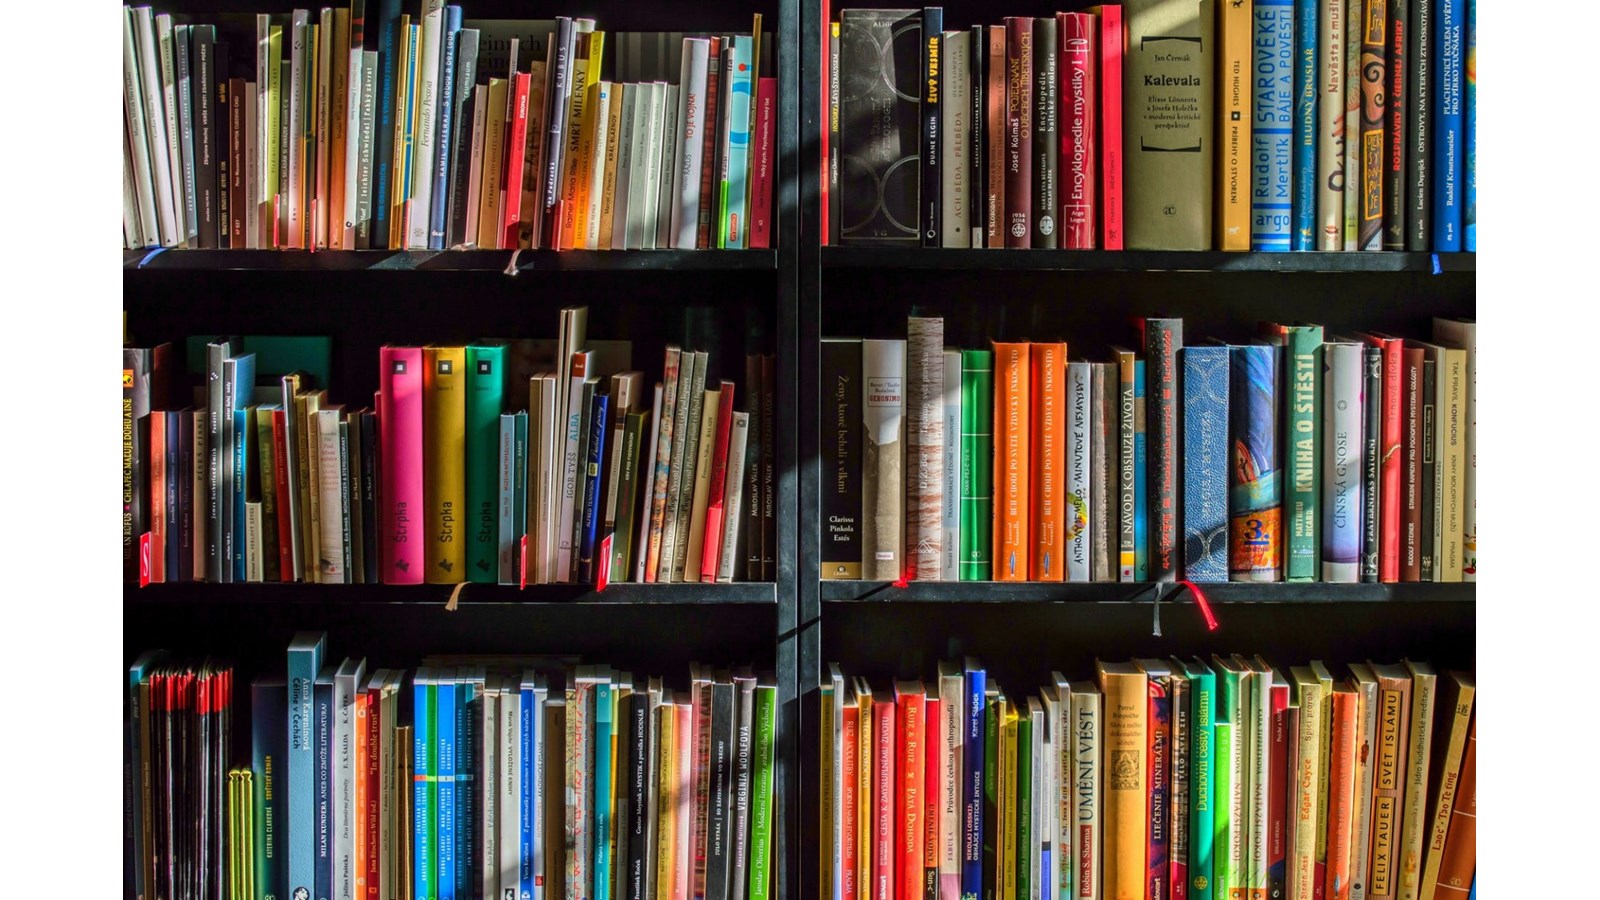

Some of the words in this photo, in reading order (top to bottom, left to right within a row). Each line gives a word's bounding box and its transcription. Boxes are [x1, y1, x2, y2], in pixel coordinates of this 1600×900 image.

[927, 37, 938, 76] VESMÍR
[1278, 10, 1292, 68] POVĚSTI
[1394, 20, 1404, 55] AFRIKY
[1144, 74, 1201, 86] Kalevala
[1255, 10, 1276, 122] STAROVĚKÉ
[1279, 75, 1290, 83] A
[1303, 48, 1314, 98] BRUSLAŘ
[1392, 59, 1402, 97] ČIERNEJ
[423, 80, 432, 106] Pessoa
[443, 75, 452, 98] tebou
[572, 69, 586, 118] MILENKY
[1038, 72, 1046, 131] Encyklopedie
[1047, 53, 1056, 95] mytologie
[1072, 68, 1084, 114] mystiky
[1279, 91, 1291, 122] BÁJE
[1302, 100, 1314, 146] BLUDNÝ
[421, 108, 431, 147] Fernando
[440, 114, 448, 148] PETERAJ
[609, 114, 617, 143] BLÁZNOV
[686, 130, 694, 140] TO
[1010, 118, 1019, 147] Kolmaš
[1392, 111, 1402, 171] ROZPRÁVKY
[1010, 150, 1019, 173] Josef
[1072, 117, 1085, 200] Encyklopedie
[1256, 136, 1269, 197] Rudolf
[567, 180, 577, 200] Maria
[565, 203, 575, 228] Rainer
[1256, 216, 1290, 231] argo
[1294, 354, 1314, 413] ŠTĚSTÍ
[570, 413, 580, 441] ALBA
[1121, 389, 1133, 429] ŽIVOTA
[1296, 420, 1313, 432] O
[1124, 432, 1133, 479] OBSLUZE
[1296, 438, 1313, 492] KNIHA
[1336, 431, 1347, 476] GNOSE
[566, 477, 576, 499] IGOR
[1334, 480, 1347, 528] ČÍNSKÁ
[393, 502, 409, 543] Štrpka
[438, 501, 453, 543] Štrpka
[478, 501, 492, 543] Štrpka
[829, 515, 854, 524] Clarissa
[1121, 493, 1133, 534] NÁVOD
[1076, 708, 1094, 756] VÉST
[1384, 695, 1396, 746] ISLÁMU
[1198, 730, 1209, 758] cesty
[320, 771, 327, 780] CO
[1302, 759, 1311, 788] Cayce
[1381, 754, 1393, 785] SVĚT
[1075, 760, 1093, 821] UMĚNÍ
[1302, 792, 1311, 820] Edgar
[1378, 802, 1390, 847] TAUER
[755, 870, 764, 895] Jaroslav
[1082, 869, 1091, 894] Robin
[1376, 853, 1386, 889] FELIX
